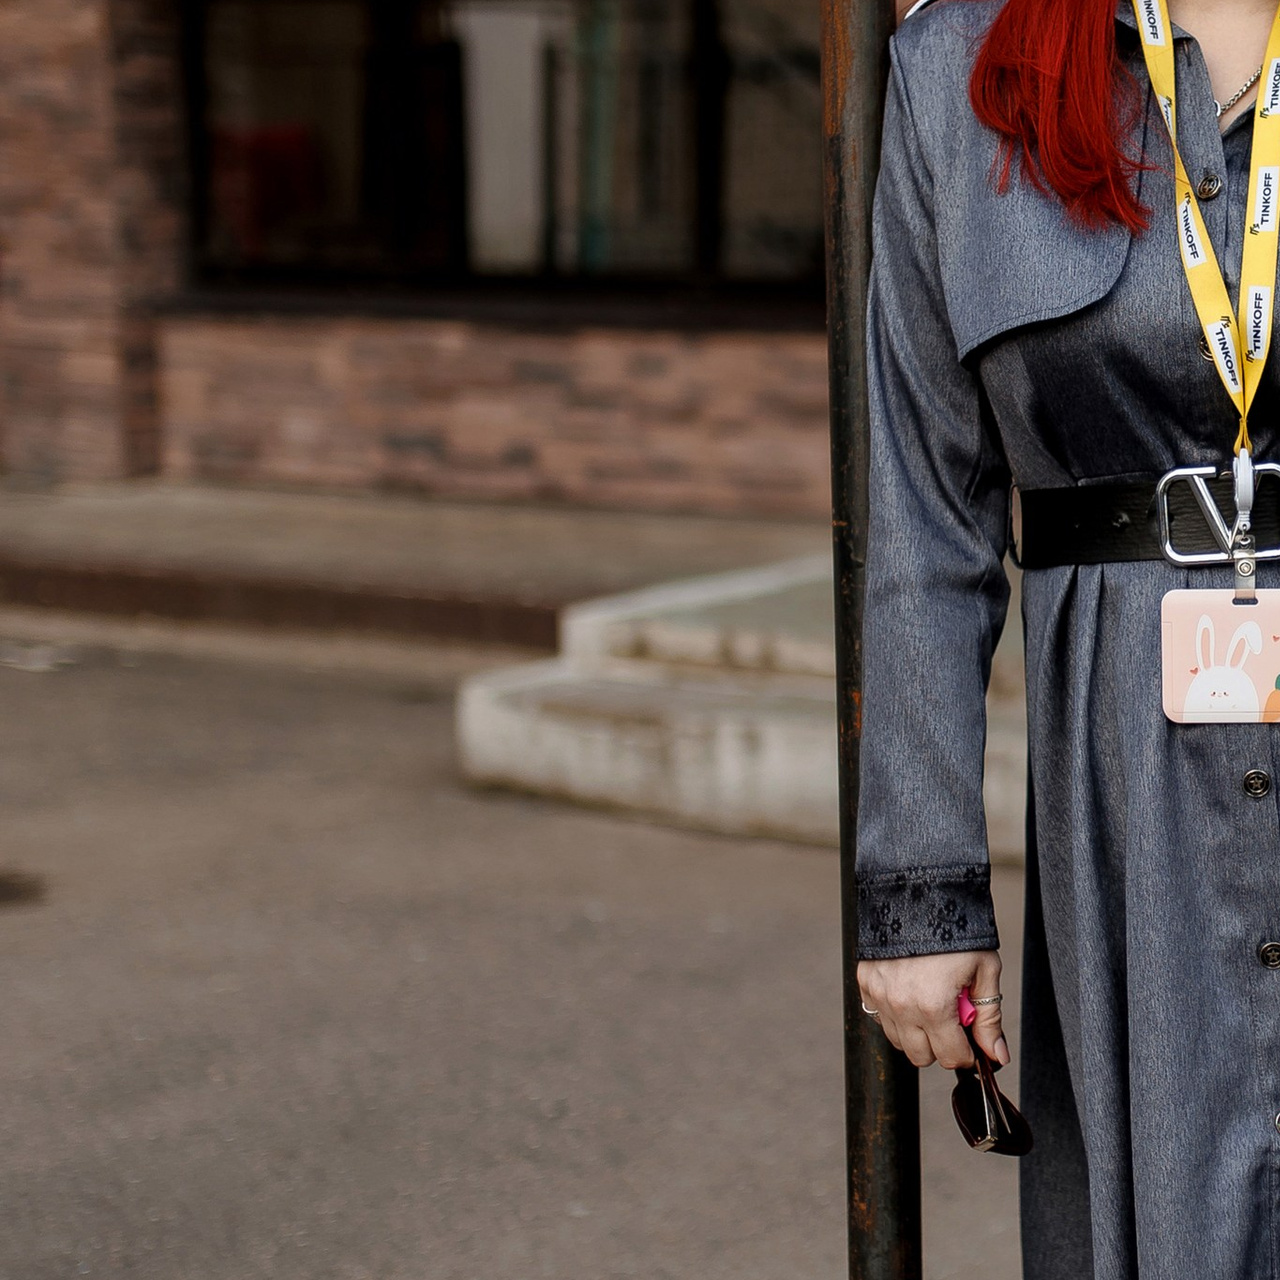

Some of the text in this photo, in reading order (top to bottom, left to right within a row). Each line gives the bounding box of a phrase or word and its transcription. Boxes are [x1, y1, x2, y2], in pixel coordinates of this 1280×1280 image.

[1260, 172, 1273, 225] TINKOFF
[1182, 205, 1199, 259] TINKOFF
[1252, 292, 1264, 352] TINKOFF
[1215, 327, 1239, 387] TINKOFF
